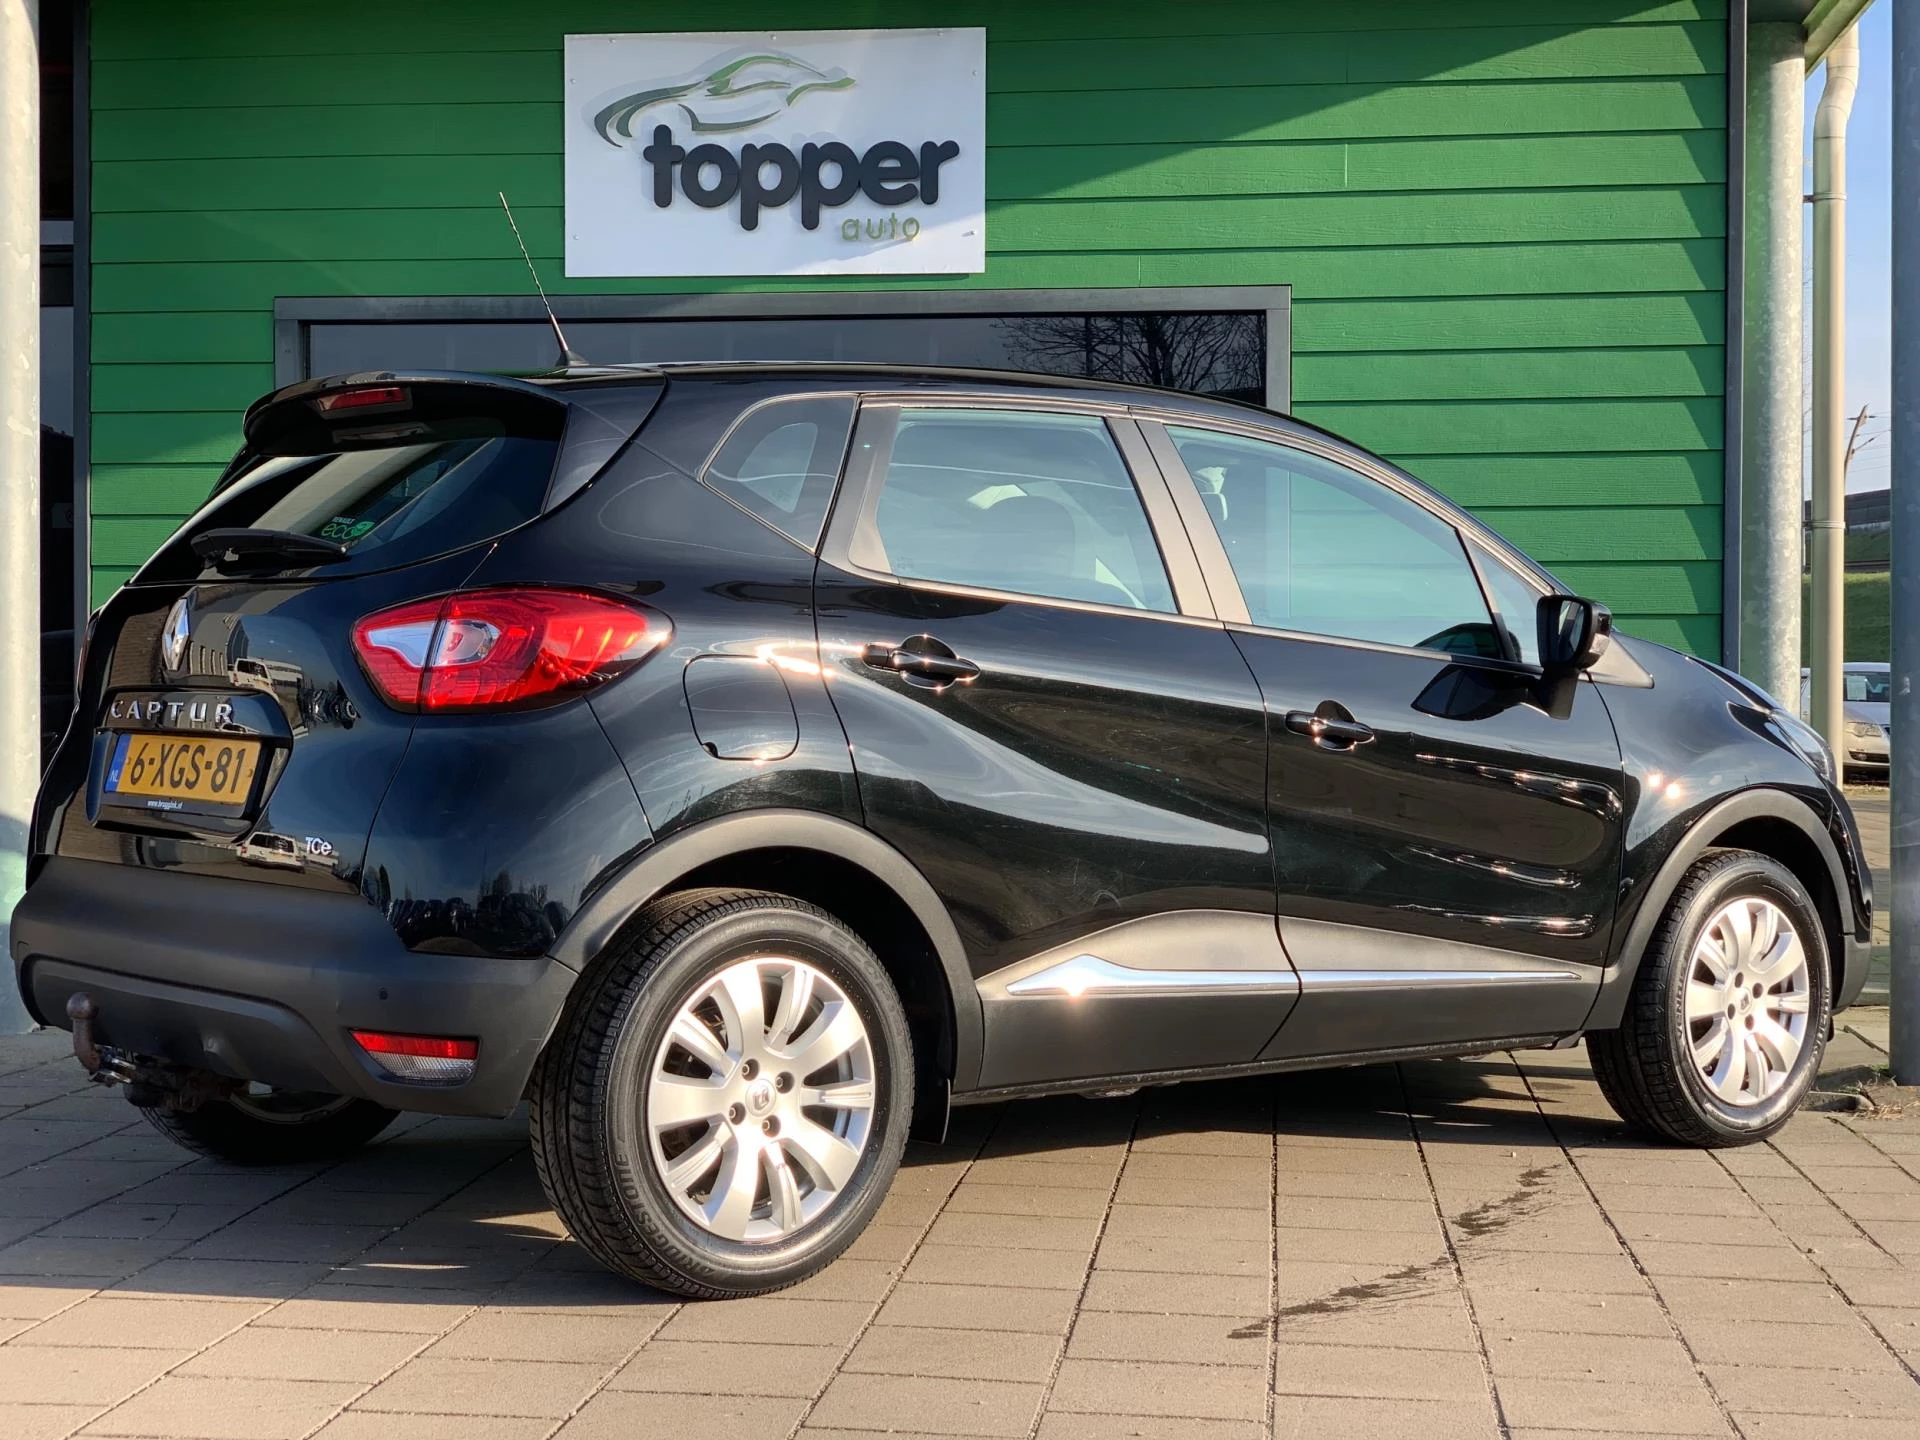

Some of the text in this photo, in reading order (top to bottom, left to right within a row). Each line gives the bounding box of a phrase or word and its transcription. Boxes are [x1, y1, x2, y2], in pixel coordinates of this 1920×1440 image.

[643, 124, 960, 231] topper
[841, 213, 920, 241] auto
[111, 700, 232, 723] CAPTUR
[130, 742, 246, 794] 6-XGS-81
[305, 836, 332, 856] TCe
